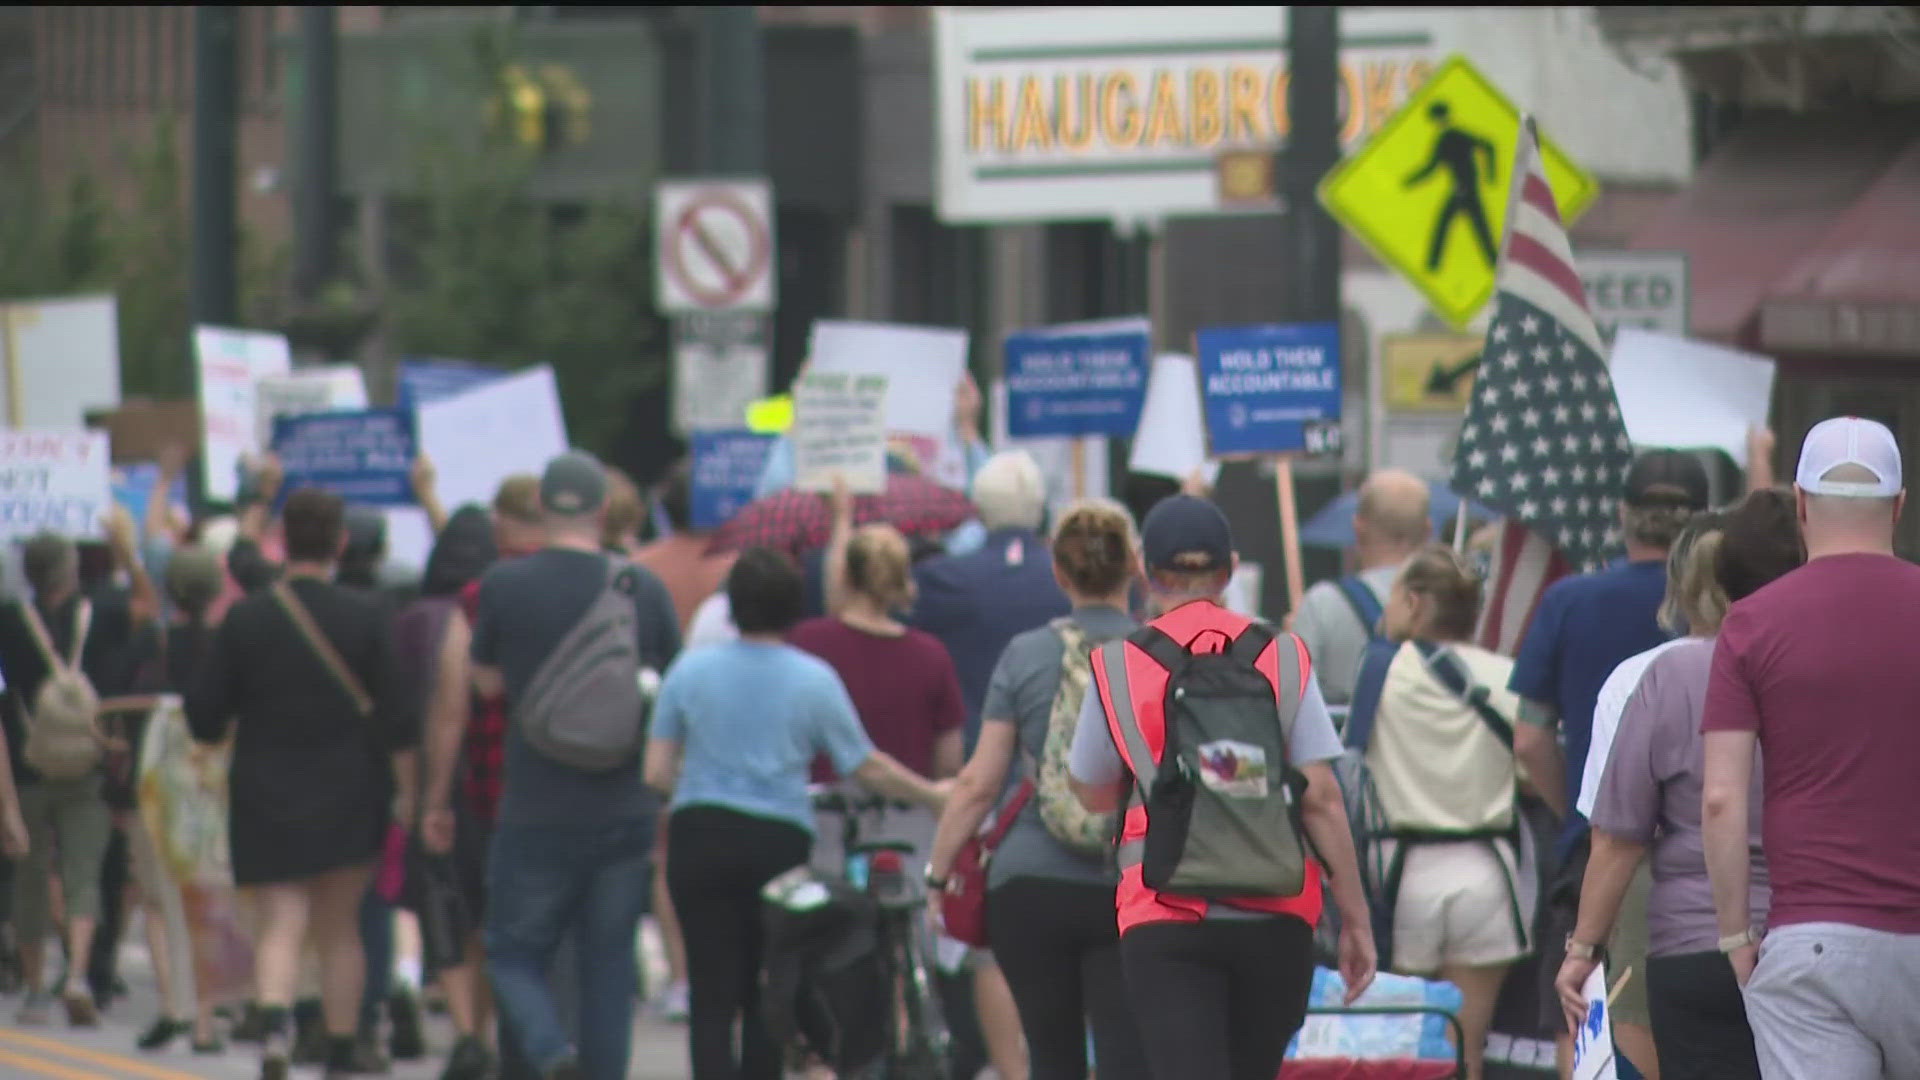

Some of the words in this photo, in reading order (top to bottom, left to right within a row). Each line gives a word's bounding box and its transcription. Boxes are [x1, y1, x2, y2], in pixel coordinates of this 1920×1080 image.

[1220, 348, 1271, 371] HOLD
[1274, 345, 1324, 368] THEM
[1208, 368, 1334, 396] ACCOUNTABLE
